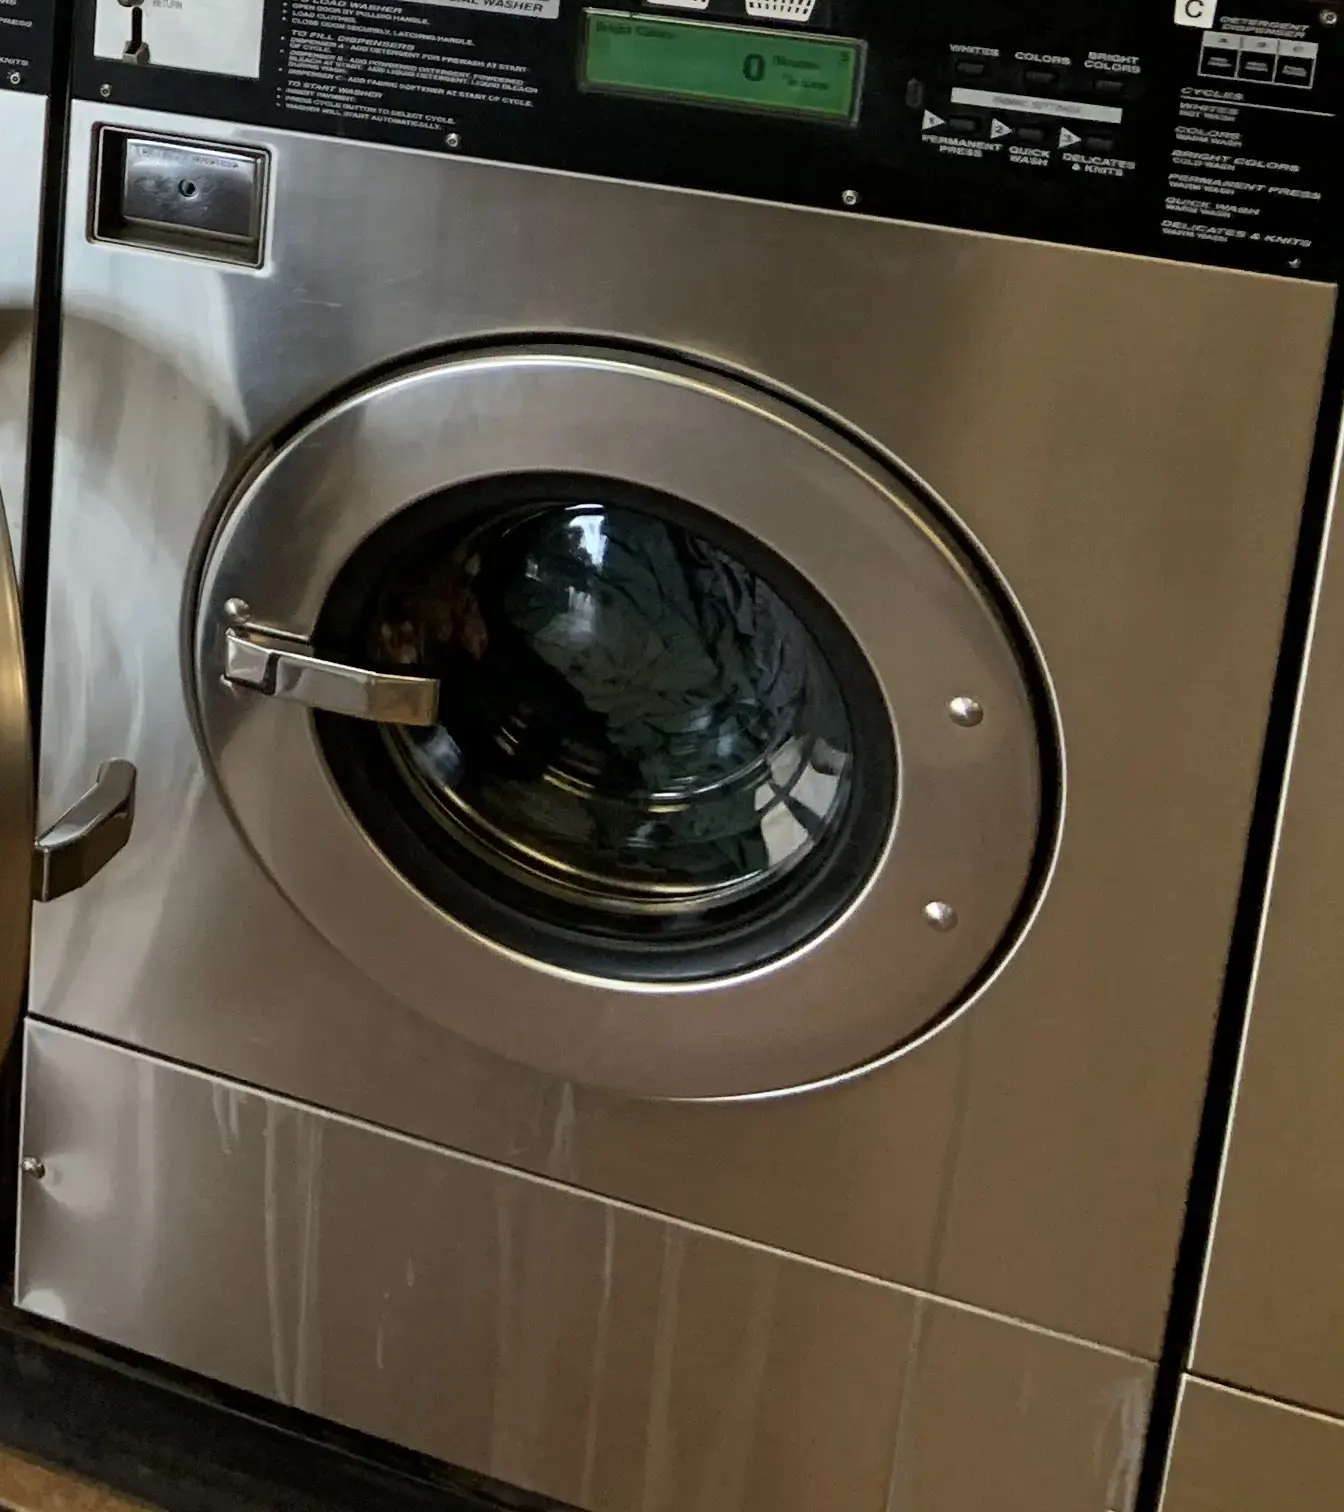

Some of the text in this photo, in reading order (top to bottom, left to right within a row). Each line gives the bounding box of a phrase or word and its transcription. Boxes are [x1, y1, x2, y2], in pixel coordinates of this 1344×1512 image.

[350, 2, 402, 14] WASHER
[1184, 0, 1204, 18] C
[950, 44, 1000, 57] WHITES
[1014, 51, 1072, 66] COLORS
[1088, 51, 1140, 65] BRIGHT
[742, 53, 766, 82] 0
[1084, 60, 1141, 74] COLORS
[1181, 87, 1245, 100] CYCLES
[922, 134, 1003, 151] PERMANENT
[939, 145, 983, 158] PRESS
[1009, 146, 1051, 158] QUICK
[1010, 155, 1049, 166] WASH
[1062, 152, 1136, 170] DELICATES
[1234, 157, 1301, 172] COLORS
[1084, 164, 1124, 176] KNITS
